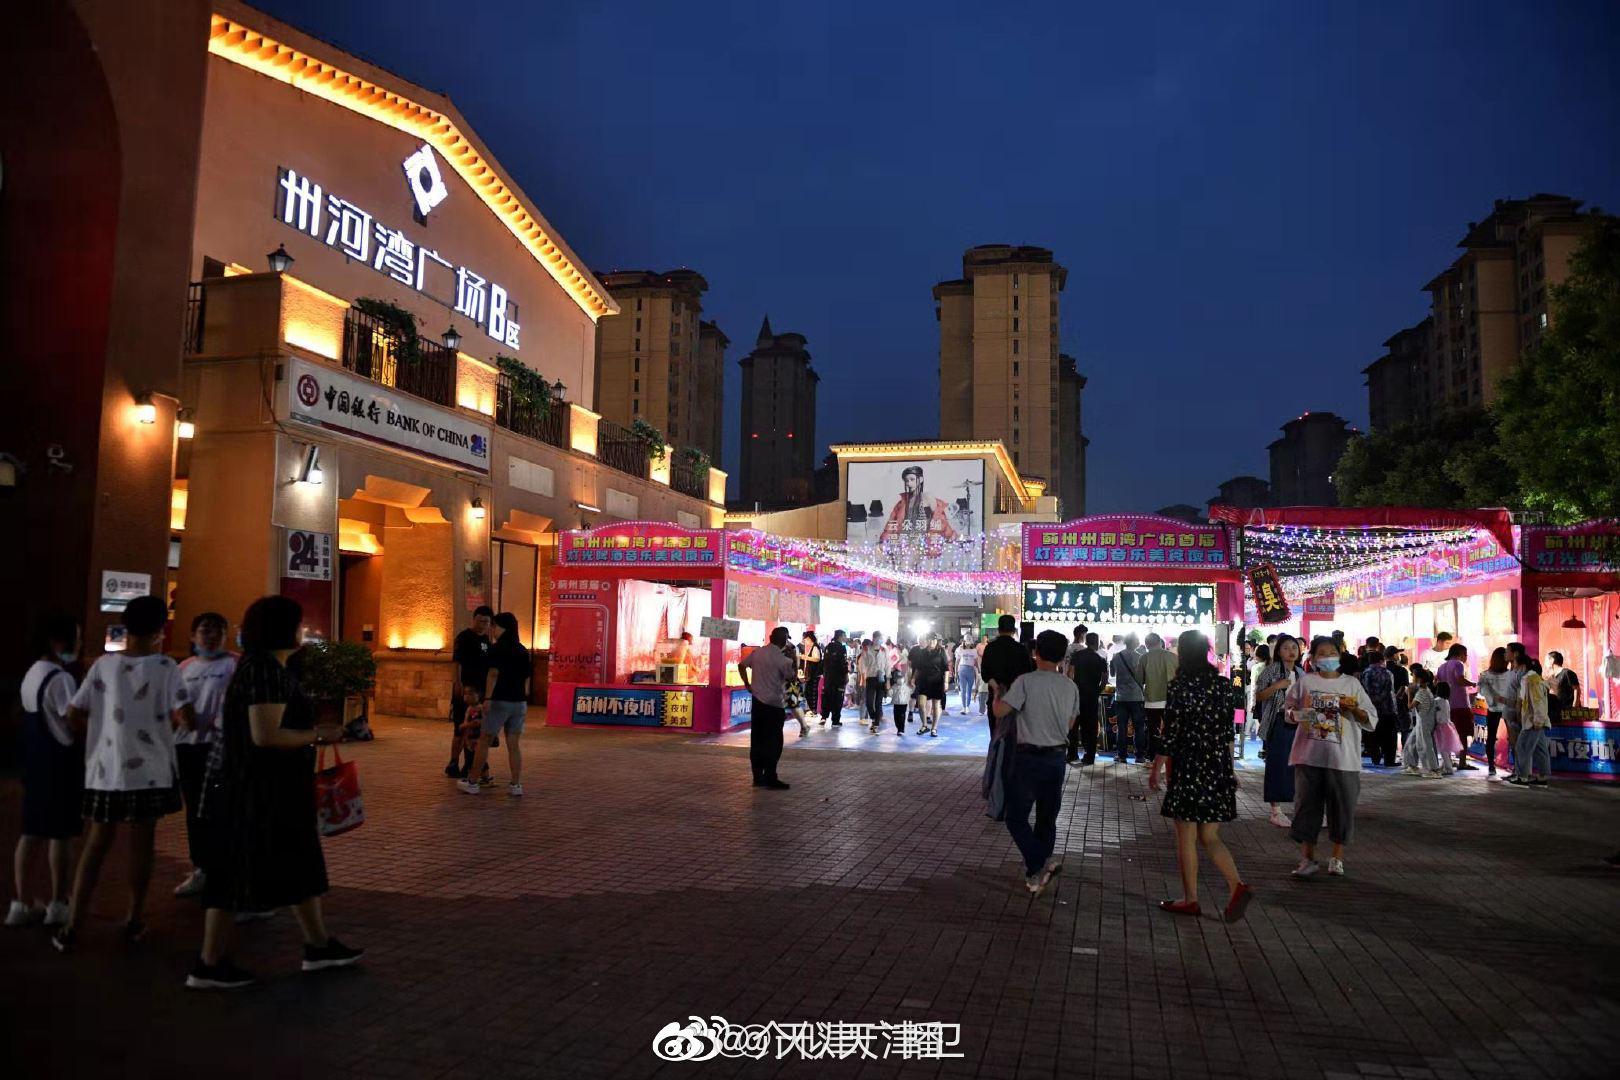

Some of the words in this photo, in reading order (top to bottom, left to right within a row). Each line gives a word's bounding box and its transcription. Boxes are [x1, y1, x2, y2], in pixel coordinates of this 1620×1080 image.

[281, 169, 520, 350] 州河湾广场B区
[324, 385, 381, 425] 中国银行
[386, 411, 420, 434] BANK
[422, 422, 436, 438] OF
[437, 427, 469, 449] CHINA
[1042, 532, 1216, 547] 蓟州州河湾广场首届
[576, 695, 656, 717] 蓟州不夜城
[671, 704, 688, 713] 夜市
[670, 716, 688, 726] 美食
